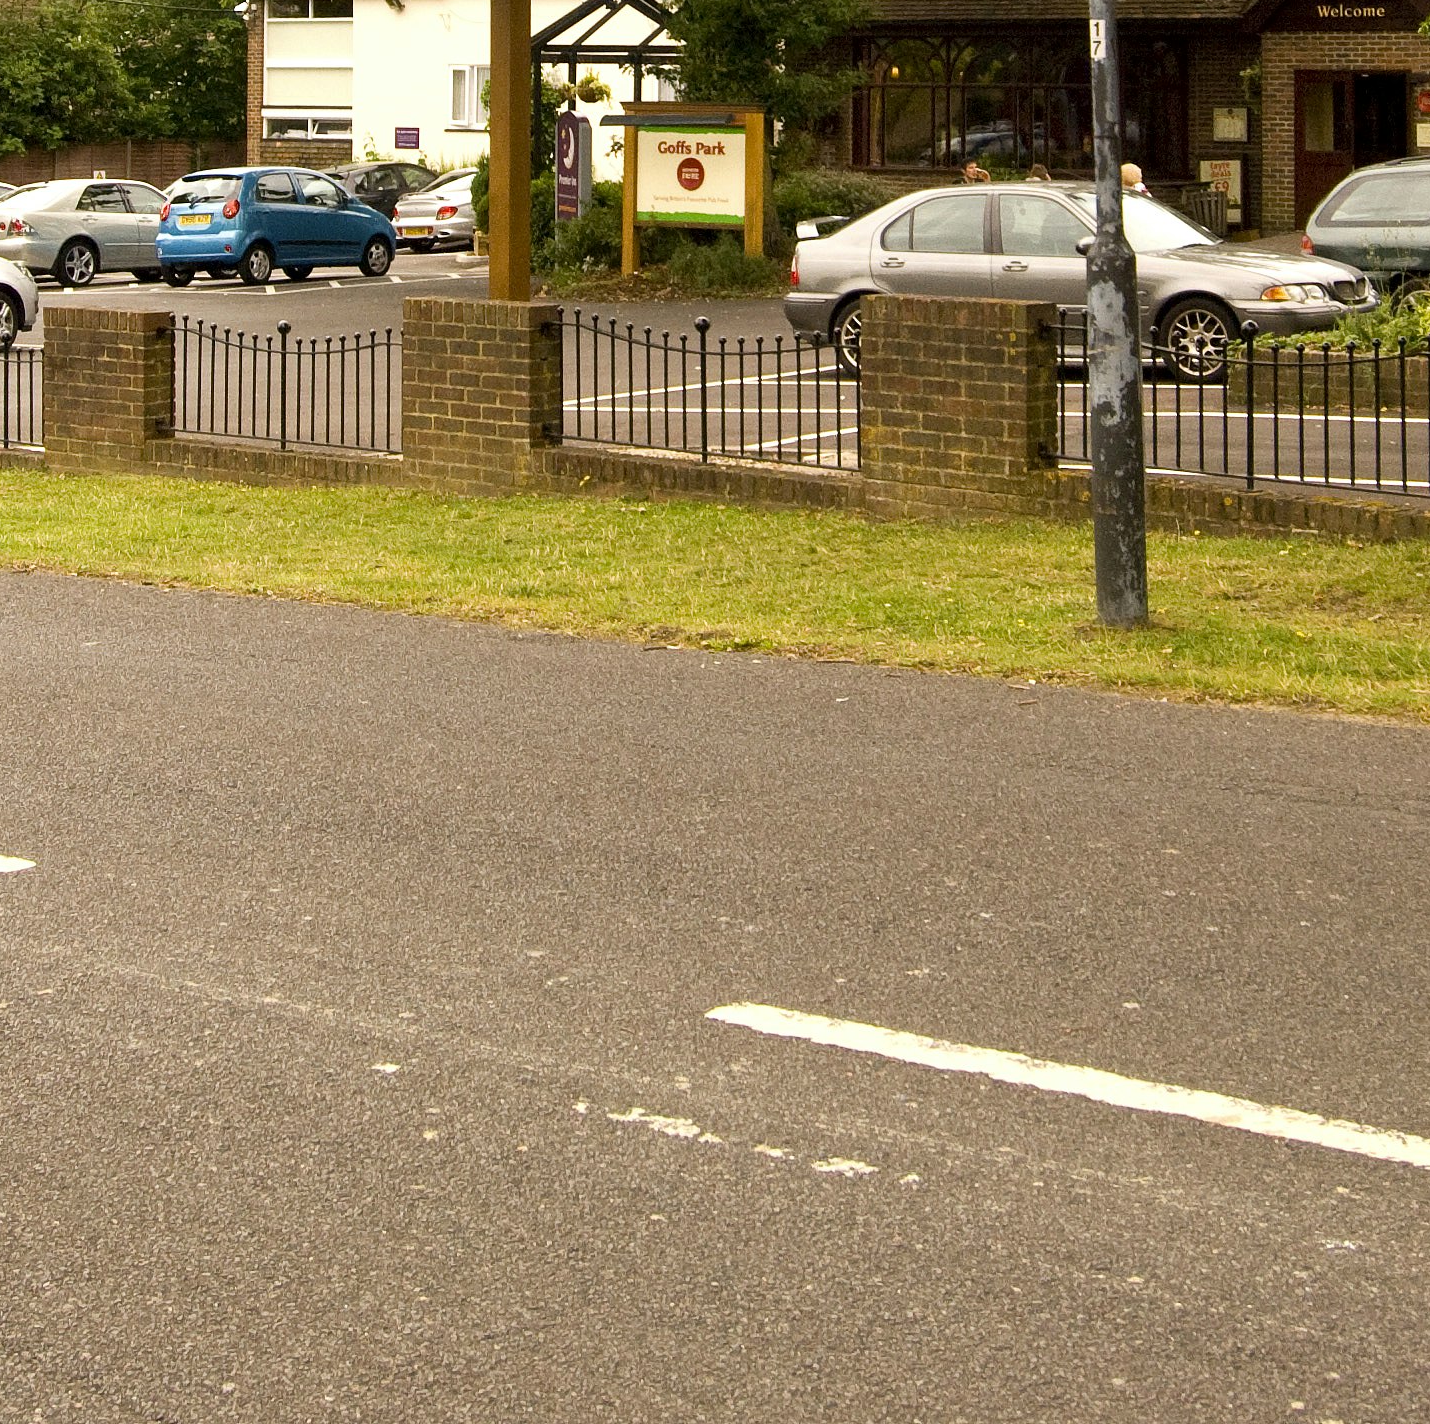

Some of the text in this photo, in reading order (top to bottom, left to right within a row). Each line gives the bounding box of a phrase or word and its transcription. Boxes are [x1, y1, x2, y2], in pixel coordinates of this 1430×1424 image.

[1316, 3, 1386, 18] Welcome
[657, 140, 726, 155] Goffs Park
